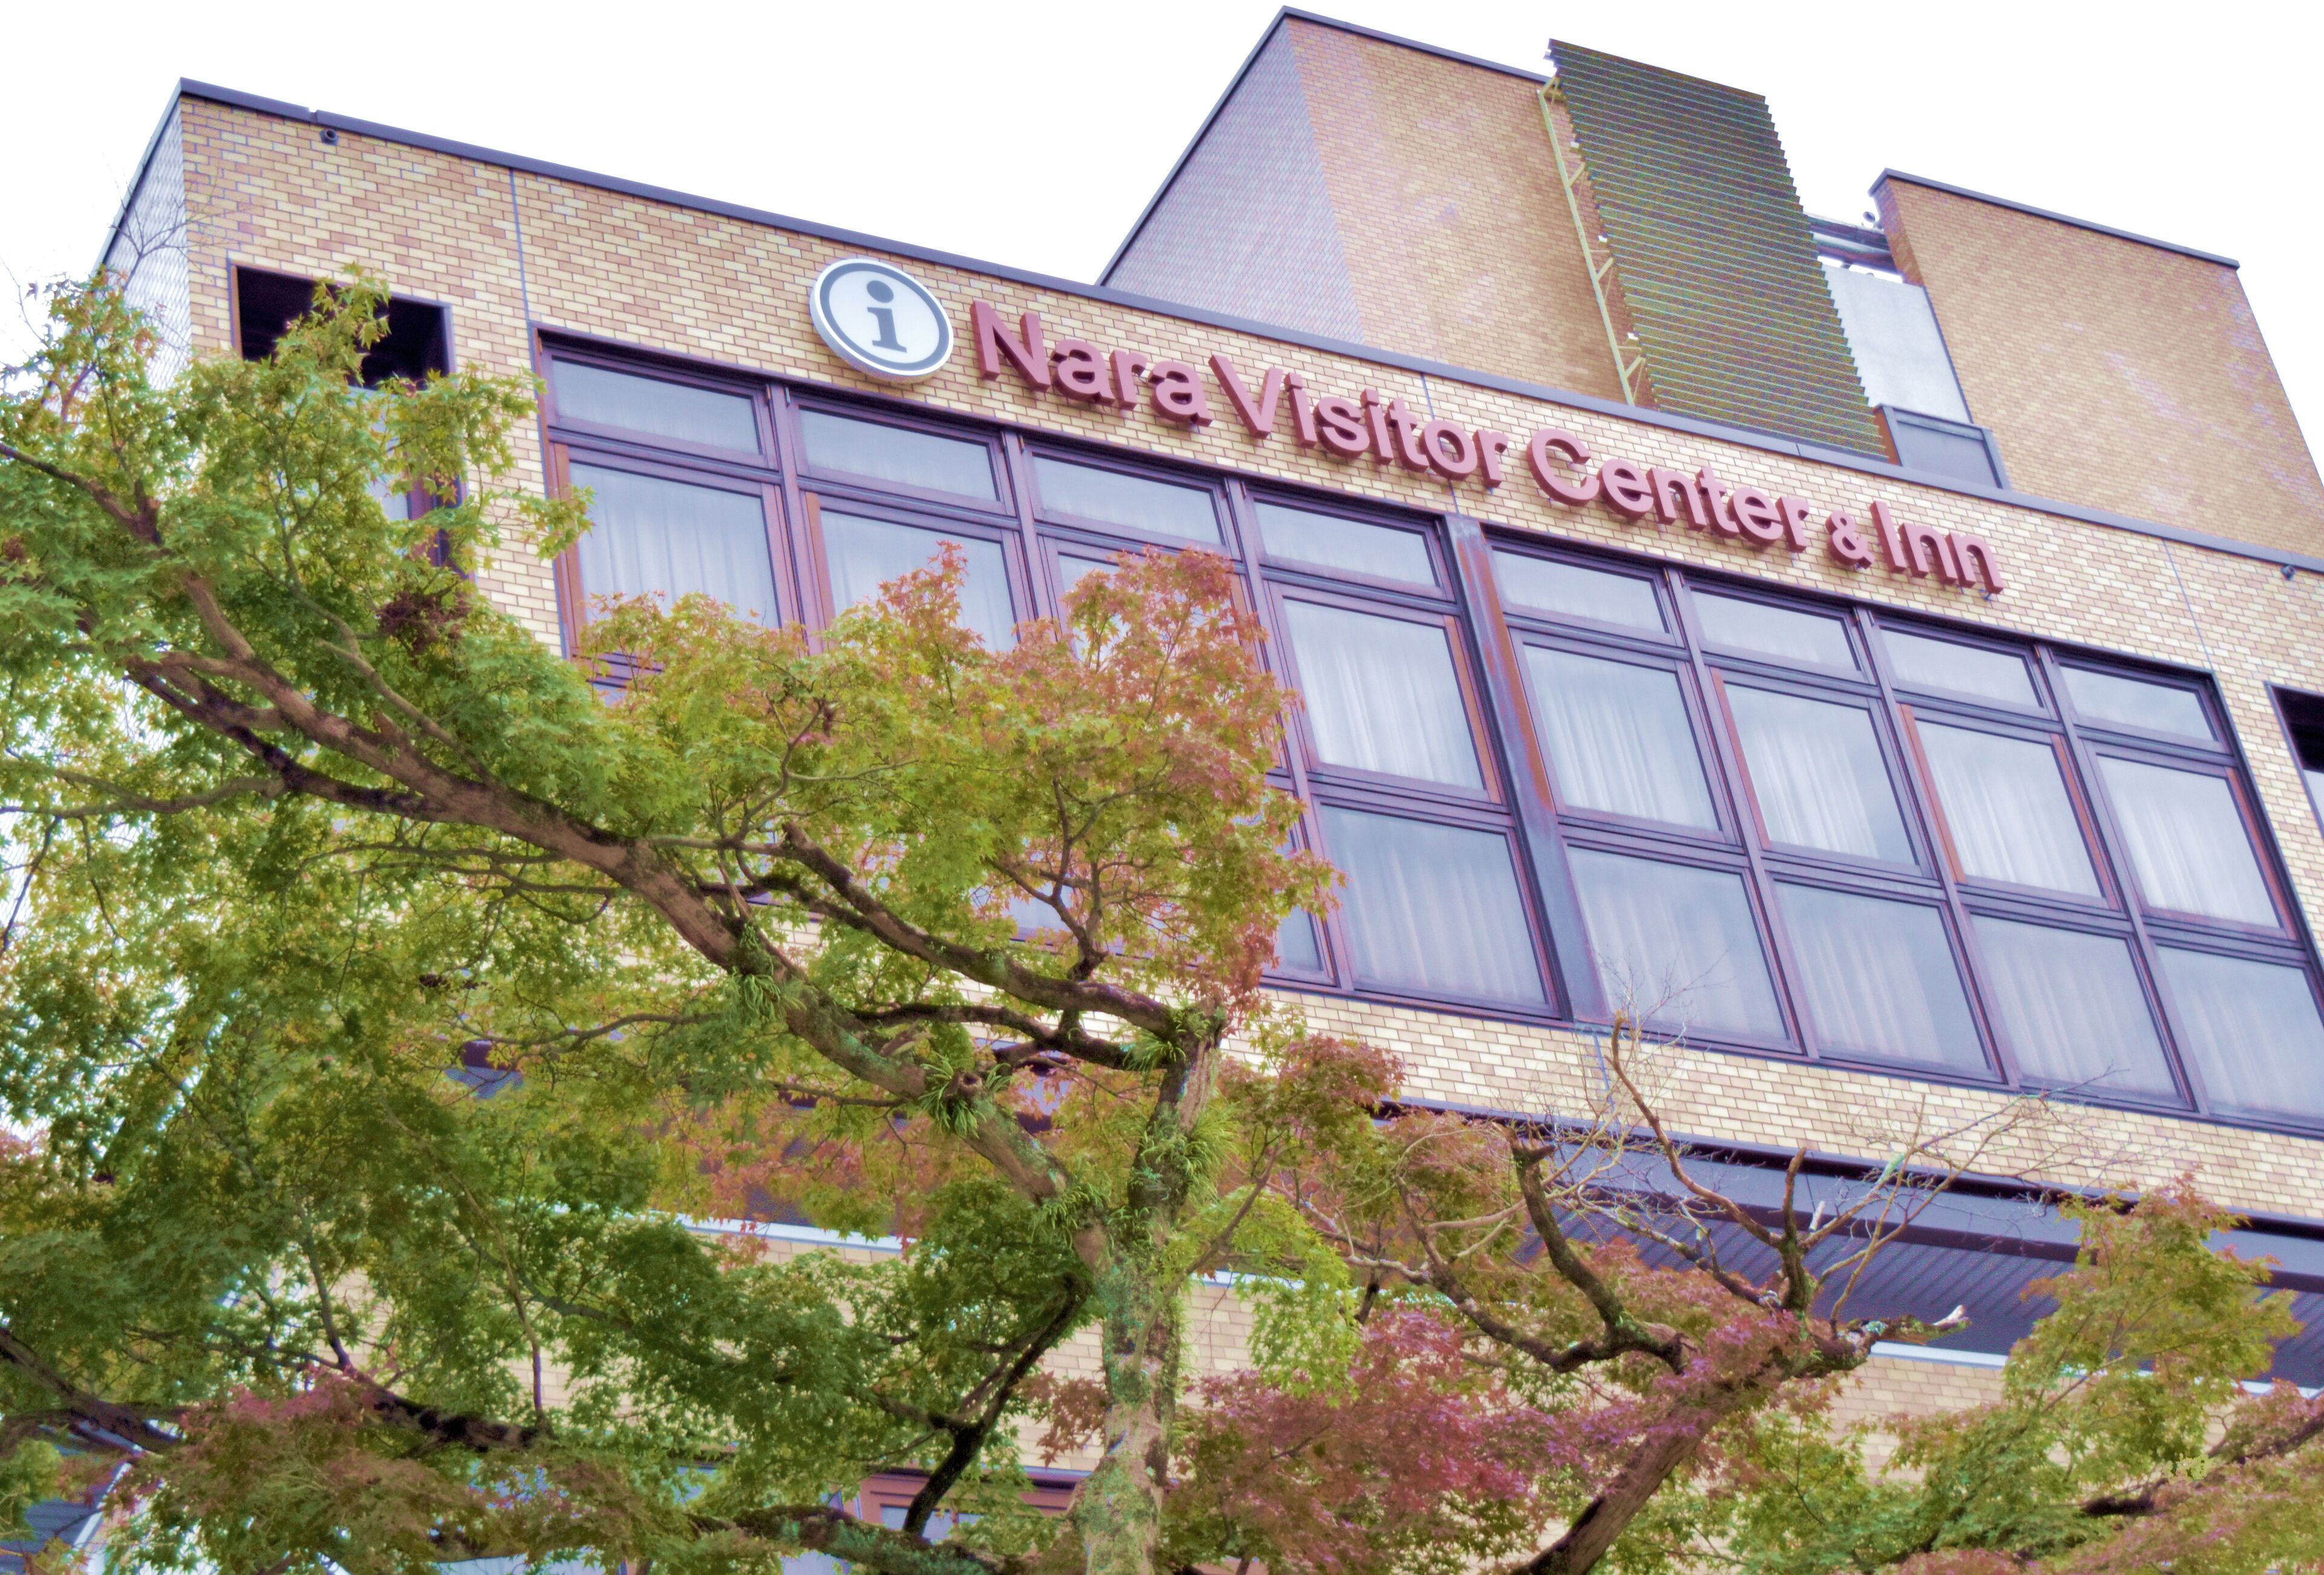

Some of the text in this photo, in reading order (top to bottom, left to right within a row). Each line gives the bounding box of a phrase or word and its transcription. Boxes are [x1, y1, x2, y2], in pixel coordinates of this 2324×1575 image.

[867, 280, 908, 353] i
[970, 300, 2004, 595] Nara Visitor Center & Inn
